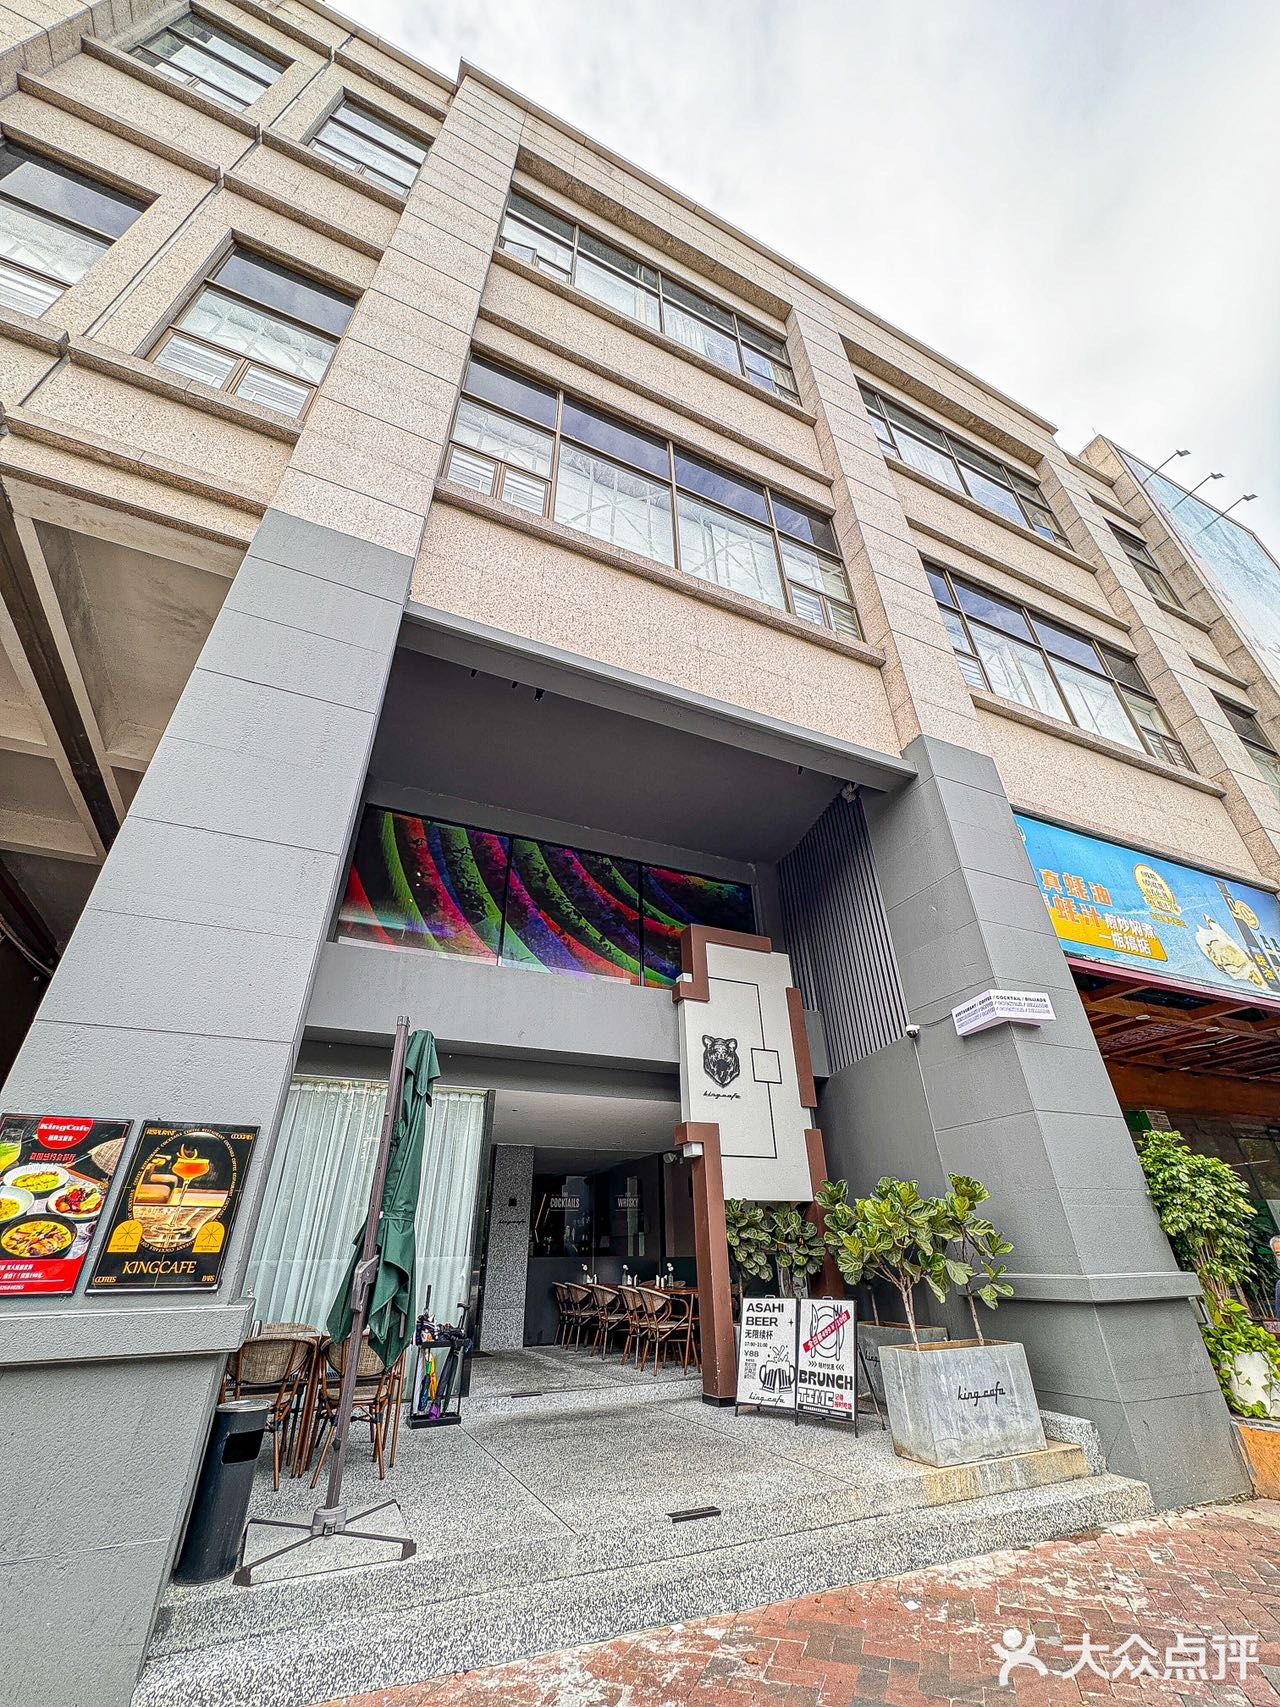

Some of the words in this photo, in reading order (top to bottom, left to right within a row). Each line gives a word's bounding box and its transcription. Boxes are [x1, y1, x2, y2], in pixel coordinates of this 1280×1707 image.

[1040, 869, 1112, 906] 真蚝油
[1042, 893, 1100, 928] 蚝汁
[38, 1123, 90, 1131] KingCafe
[550, 1197, 580, 1208] COCKTAILS
[122, 1260, 197, 1274] KINGCAFE
[746, 1303, 784, 1313] ASAHI
[745, 1316, 779, 1327] BEER
[744, 1329, 774, 1340] 无限续杯
[799, 1369, 853, 1391] BRUNCH
[798, 1386, 834, 1407] TIME
